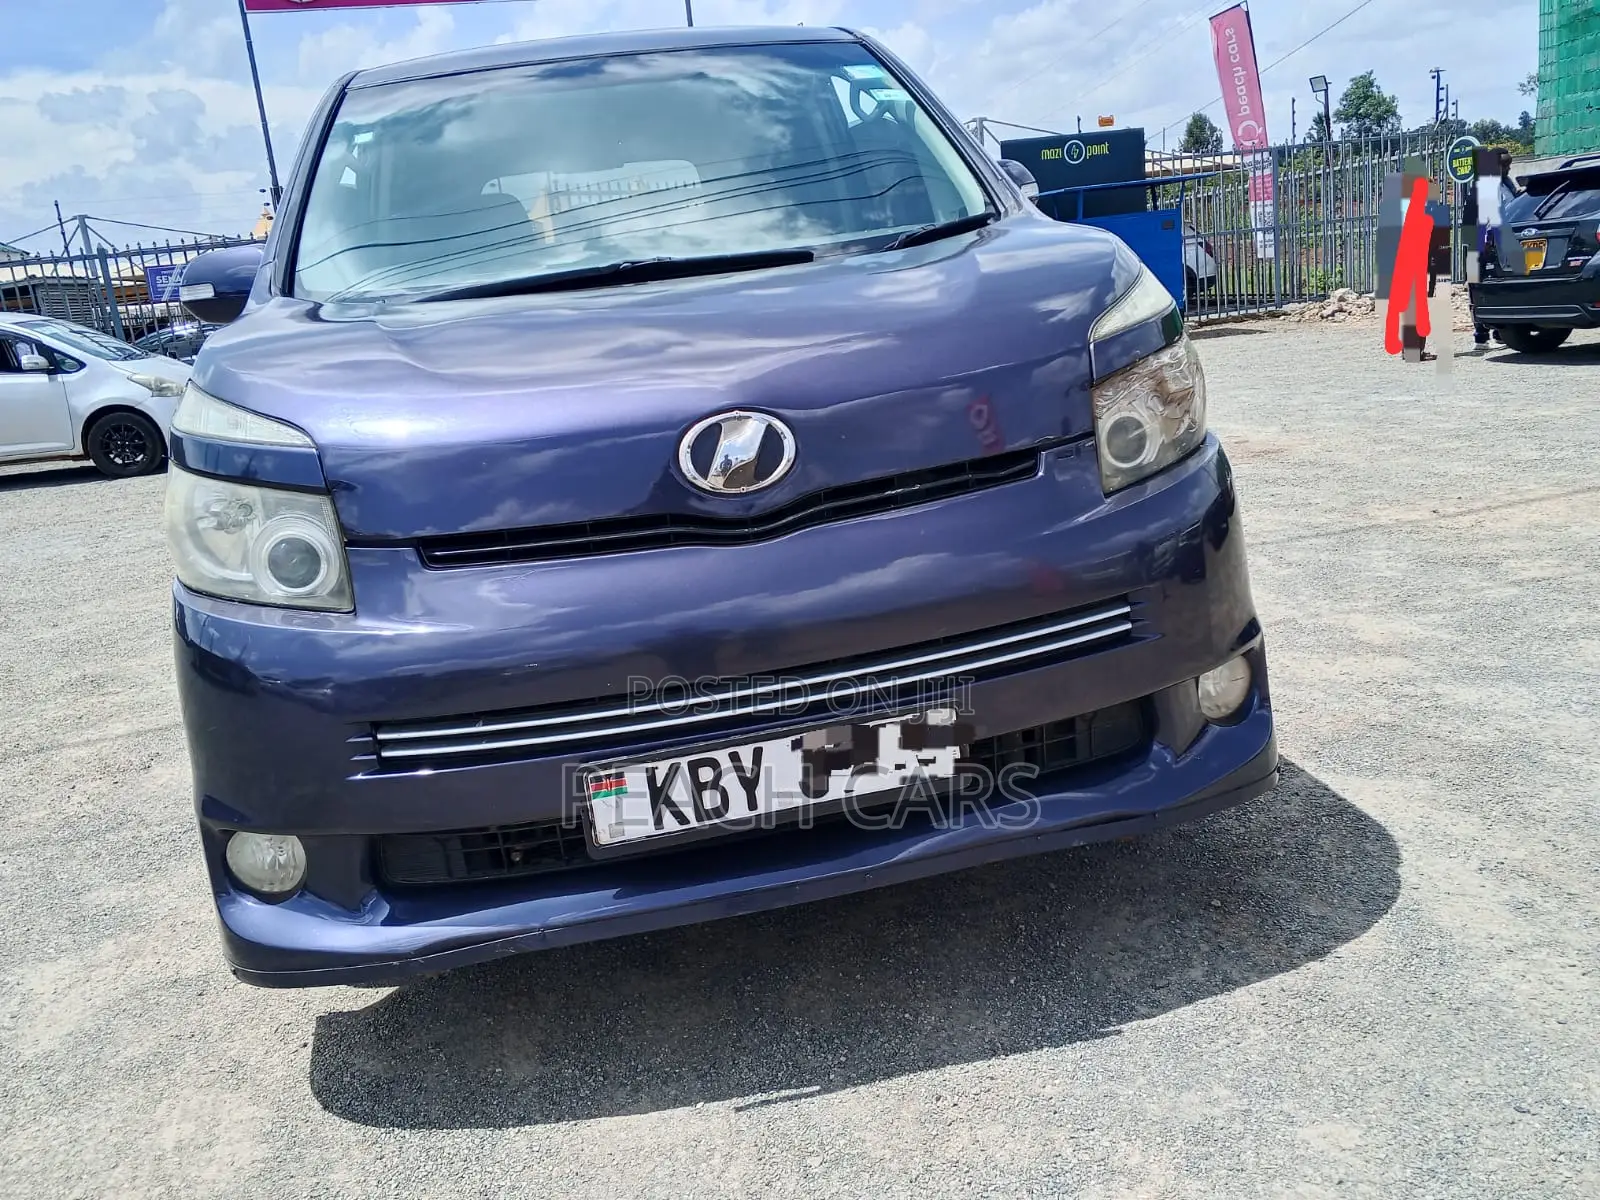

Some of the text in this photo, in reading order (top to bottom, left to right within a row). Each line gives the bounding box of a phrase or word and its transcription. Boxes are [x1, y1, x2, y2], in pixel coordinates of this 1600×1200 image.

[1086, 141, 1109, 160] point
[1452, 156, 1473, 168] BATTER
[645, 746, 764, 831] KBY
